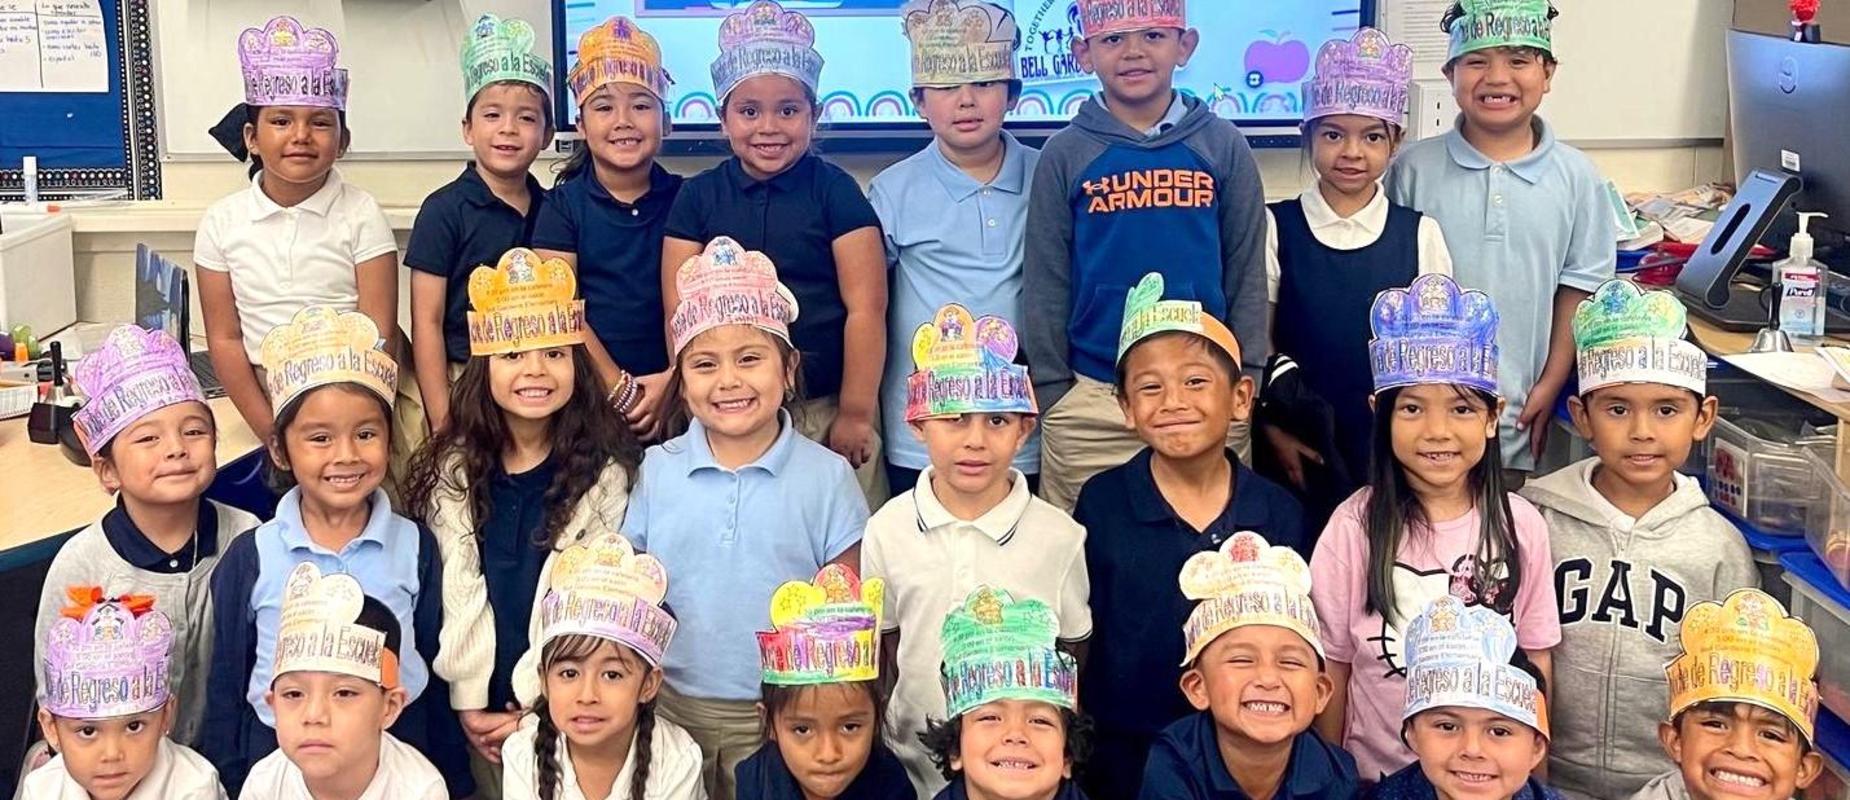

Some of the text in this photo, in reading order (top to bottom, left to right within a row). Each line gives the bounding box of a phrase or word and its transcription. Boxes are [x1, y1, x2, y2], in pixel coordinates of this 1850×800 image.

[1021, 55, 1048, 78] BELL
[1112, 169, 1214, 193] UNDER
[1088, 188, 1214, 213] ARMOUR
[1651, 334, 1665, 370] la
[284, 354, 335, 387] Regreso
[1554, 558, 1687, 643] GAP
[321, 621, 334, 657] la
[1462, 667, 1473, 694] a
[1476, 658, 1491, 697] la
[1708, 651, 1774, 693] Regreso
[71, 671, 129, 713] Regreso
